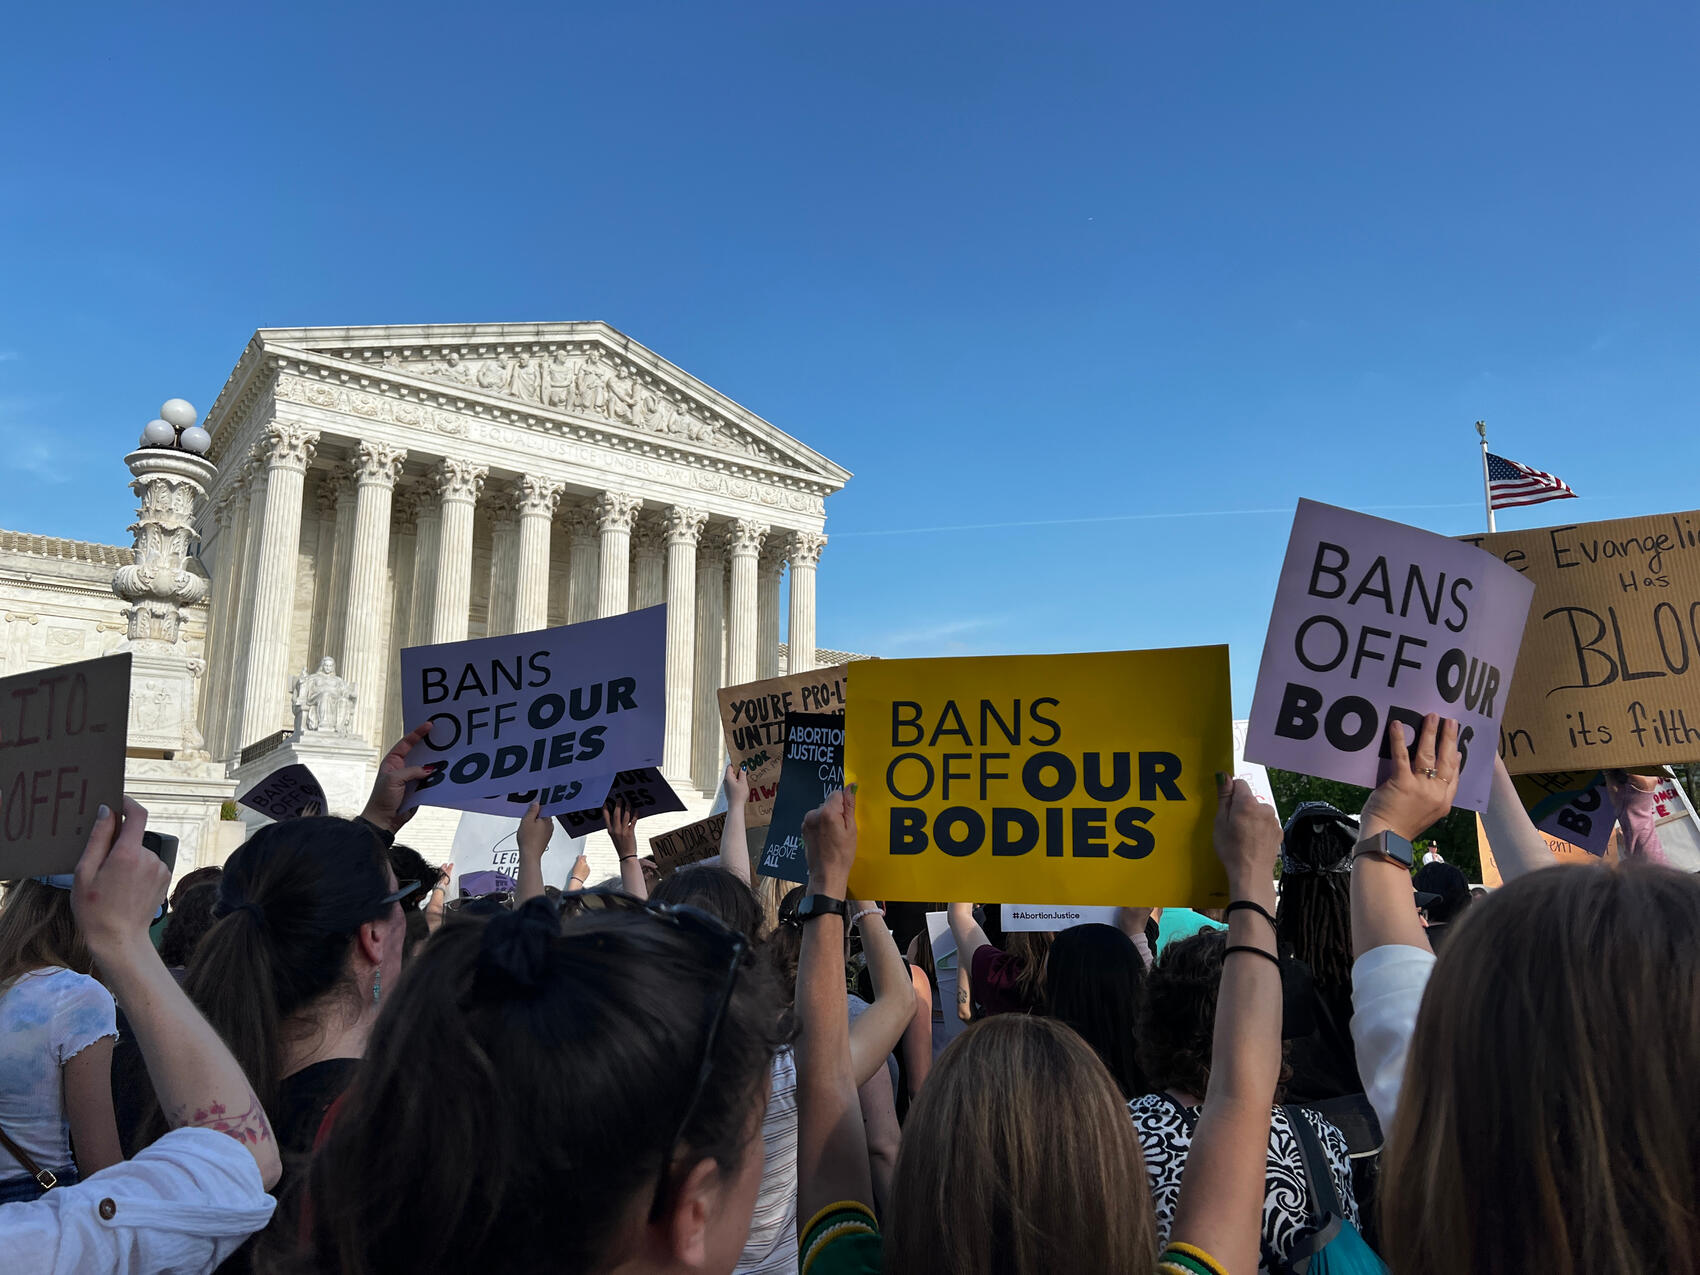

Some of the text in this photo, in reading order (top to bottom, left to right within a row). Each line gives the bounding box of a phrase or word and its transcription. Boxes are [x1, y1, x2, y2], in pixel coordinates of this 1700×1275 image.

[480, 425, 681, 481] EQUAL JUSTICE UNDER LAW
[1308, 541, 1474, 633] BANS
[1619, 569, 1670, 593] Has
[422, 650, 552, 705] BANS
[1294, 614, 1500, 719] OFF OUR
[422, 676, 638, 752] OFF OUR
[801, 676, 848, 711] PRO-L
[891, 696, 1061, 748] BANS
[1274, 682, 1474, 776] BODS
[1566, 711, 1613, 748] its
[1627, 700, 1700, 748] filth
[415, 725, 608, 793] BODIES
[787, 745, 835, 763] JUSTICE
[885, 752, 1011, 801] OFF
[1021, 751, 1186, 802] OUR
[5, 767, 88, 841] OFF!
[252, 774, 297, 807] BANS
[270, 790, 301, 815] OFF
[1557, 787, 1602, 837] BO
[655, 834, 678, 859] NOT
[676, 823, 709, 851] YOUR
[766, 843, 797, 860] ABOVE
[783, 835, 798, 848] ALL
[889, 805, 1156, 860] BODIES
[763, 855, 779, 868] ALL
[1012, 911, 1081, 921] #AbortionJustice
